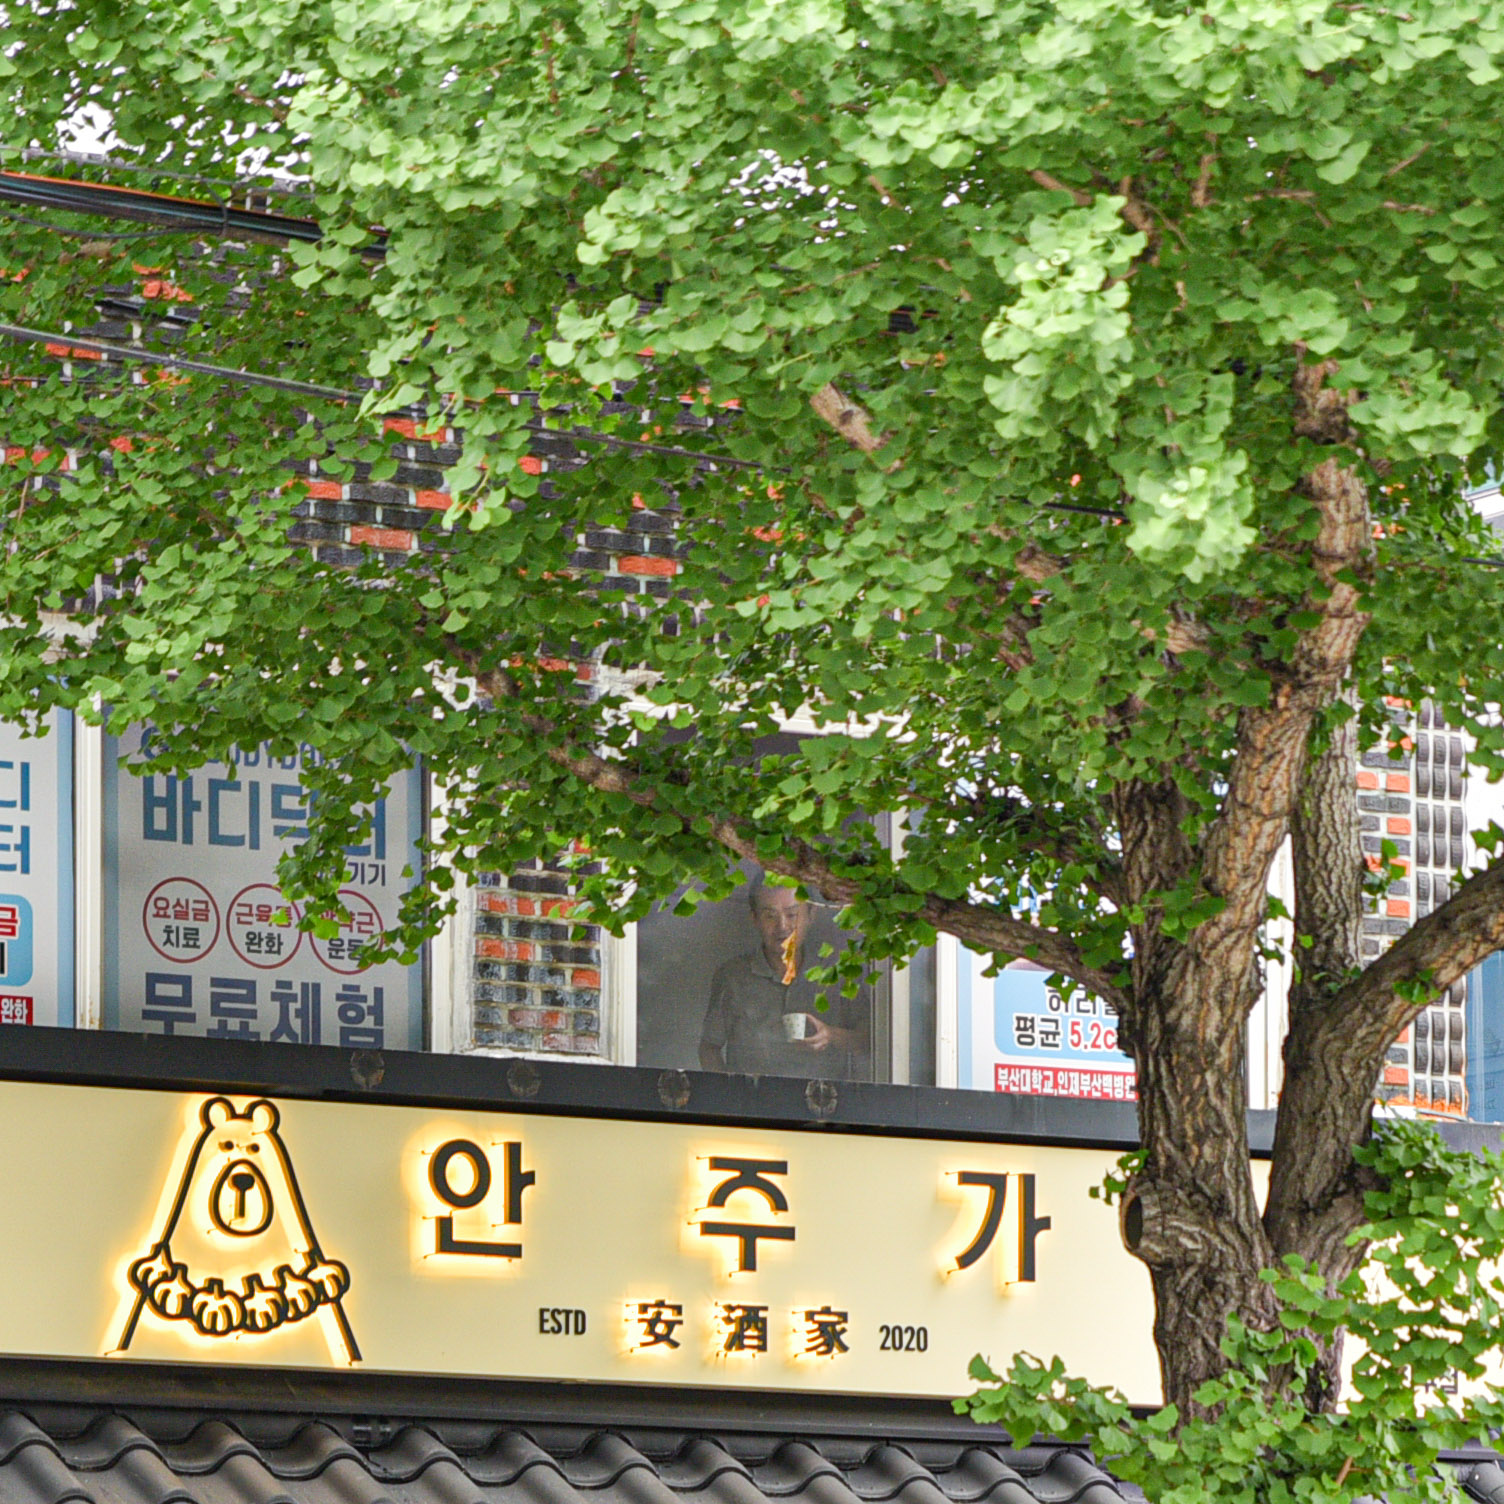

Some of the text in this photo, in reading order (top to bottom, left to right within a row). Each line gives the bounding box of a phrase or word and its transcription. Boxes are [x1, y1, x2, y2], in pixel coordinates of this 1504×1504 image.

[152, 896, 210, 922] 요실금
[163, 925, 201, 949] 치료
[245, 931, 283, 955] 완화
[0, 997, 29, 1026] 완화
[142, 972, 385, 1049] 무료체험
[1015, 1015, 1060, 1048] 평균
[539, 1308, 586, 1336] ESTD
[879, 1325, 928, 1353] 2020
